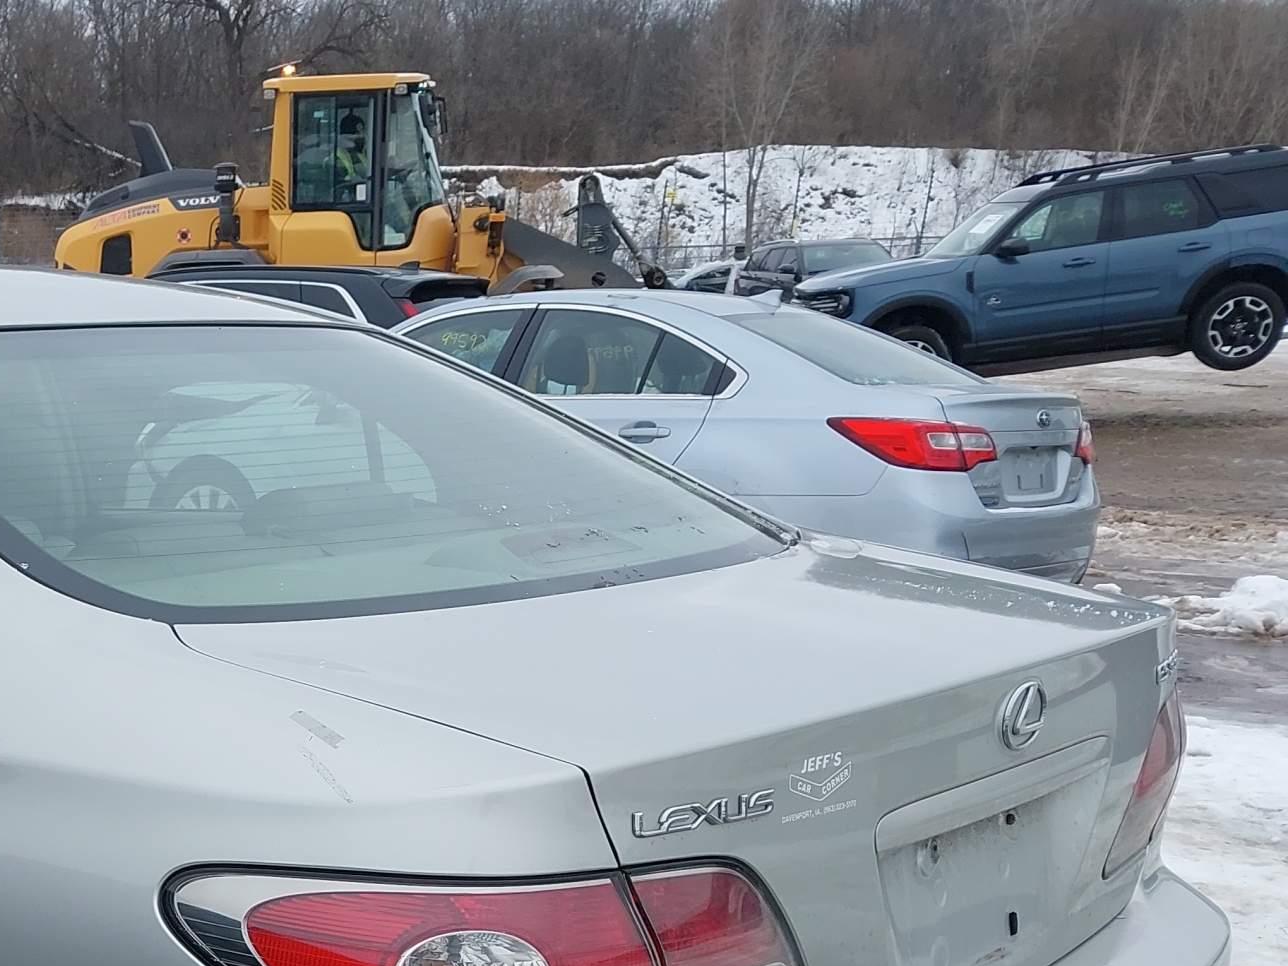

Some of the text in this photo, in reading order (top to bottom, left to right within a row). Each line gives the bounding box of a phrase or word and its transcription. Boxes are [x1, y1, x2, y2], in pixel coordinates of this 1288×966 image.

[177, 195, 220, 207] VOLV
[801, 751, 842, 774] JEFF'S
[797, 768, 849, 795] CAR CORNER
[631, 788, 776, 839] LEXUS
